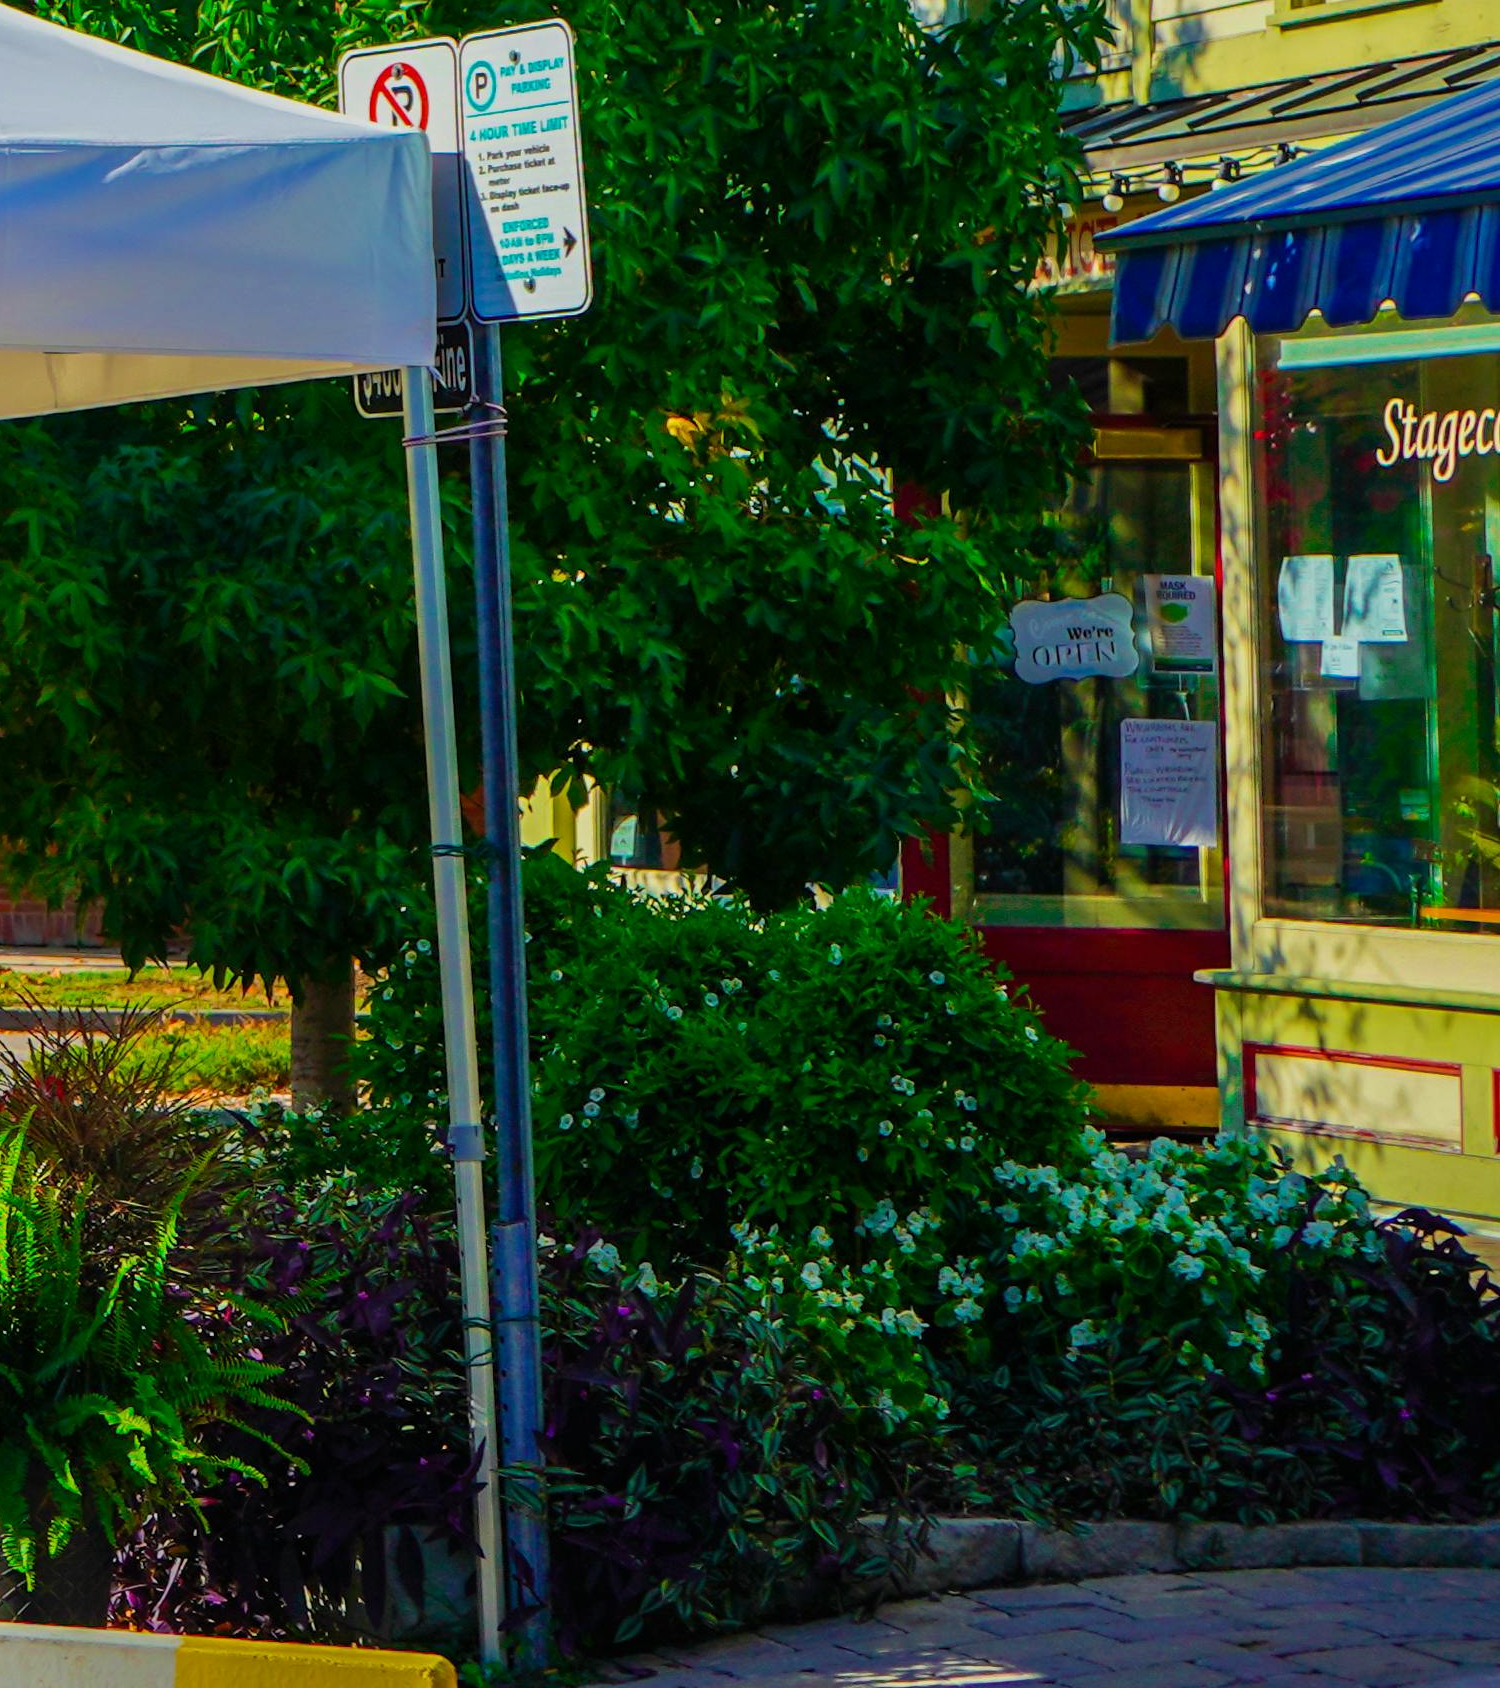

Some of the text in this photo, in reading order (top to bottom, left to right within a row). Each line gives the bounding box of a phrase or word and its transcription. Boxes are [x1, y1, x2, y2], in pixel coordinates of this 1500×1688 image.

[500, 66, 516, 78] PAY
[528, 57, 565, 73] DISPLAY
[511, 77, 551, 95] PARKING
[469, 115, 569, 141] 4 HOUR TIME LIMIT
[487, 150, 503, 161] Park
[506, 149, 522, 160] your
[524, 144, 550, 155] vehicle
[488, 162, 522, 173] Purchase
[524, 159, 546, 169] ticket
[502, 217, 549, 234] ENFORCED
[1160, 581, 1187, 591] MASK
[1067, 625, 1114, 641] We're
[1032, 641, 1115, 667] OPEN
